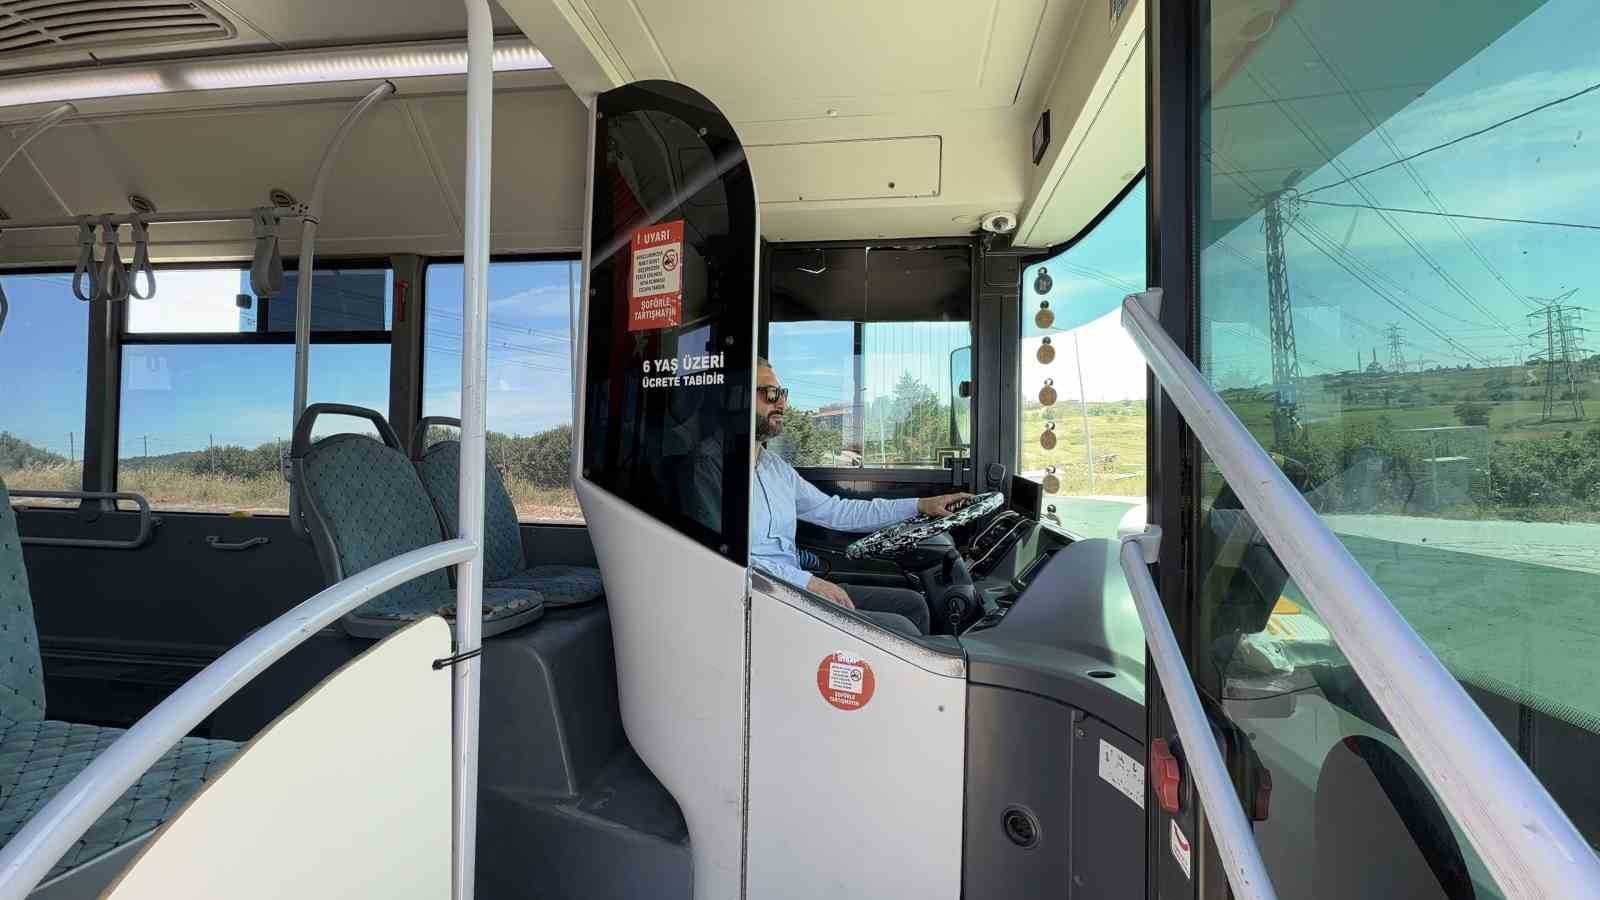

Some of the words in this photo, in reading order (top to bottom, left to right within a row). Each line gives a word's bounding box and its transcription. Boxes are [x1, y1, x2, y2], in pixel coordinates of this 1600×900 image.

[644, 230, 670, 244] UYARI
[642, 360, 651, 373] 6
[654, 358, 678, 375] YAŞ
[683, 351, 724, 370] ÜZERİ
[642, 376, 681, 388] ÜCRETE
[683, 371, 724, 387] TABİDİR
